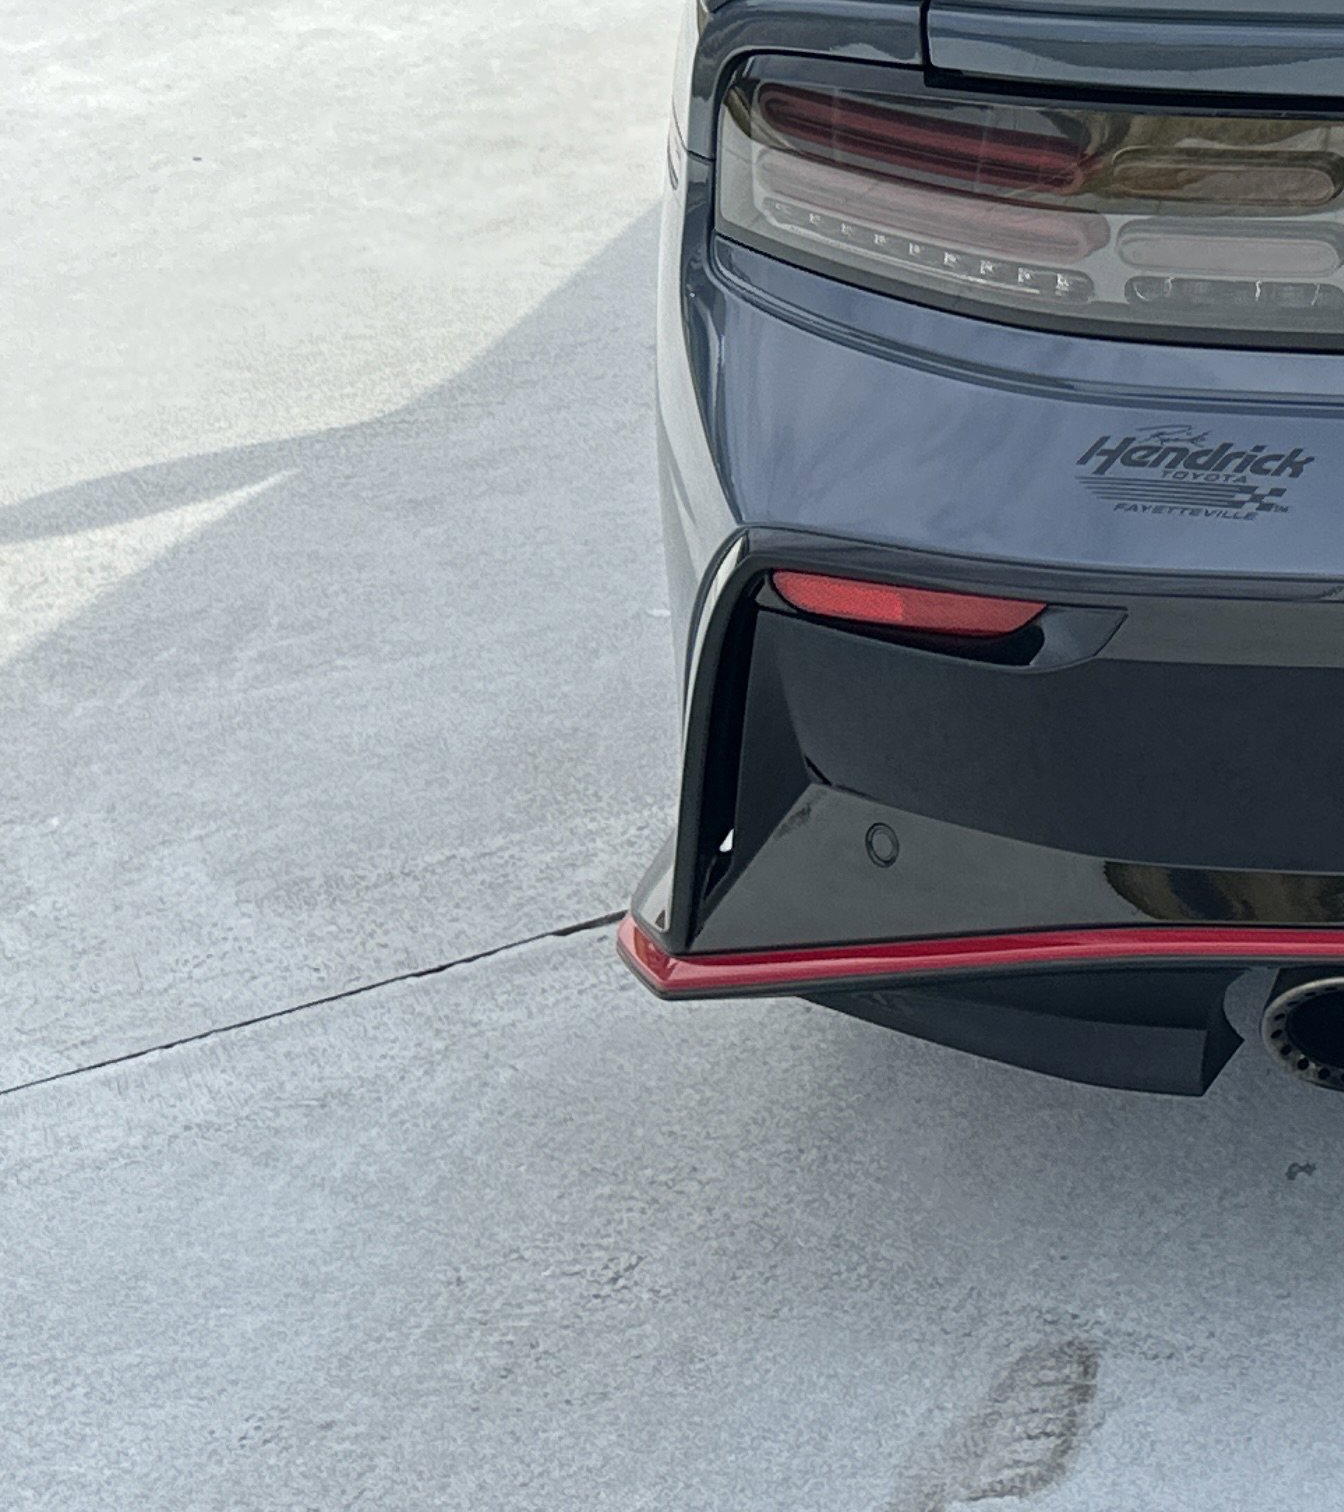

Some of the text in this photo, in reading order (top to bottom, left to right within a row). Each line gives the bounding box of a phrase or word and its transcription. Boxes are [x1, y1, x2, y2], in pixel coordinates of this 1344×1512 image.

[1075, 435, 1316, 479] Hendrick
[1161, 470, 1249, 484] TOYOTA
[1112, 502, 1259, 521] FAYETTEVILLE
